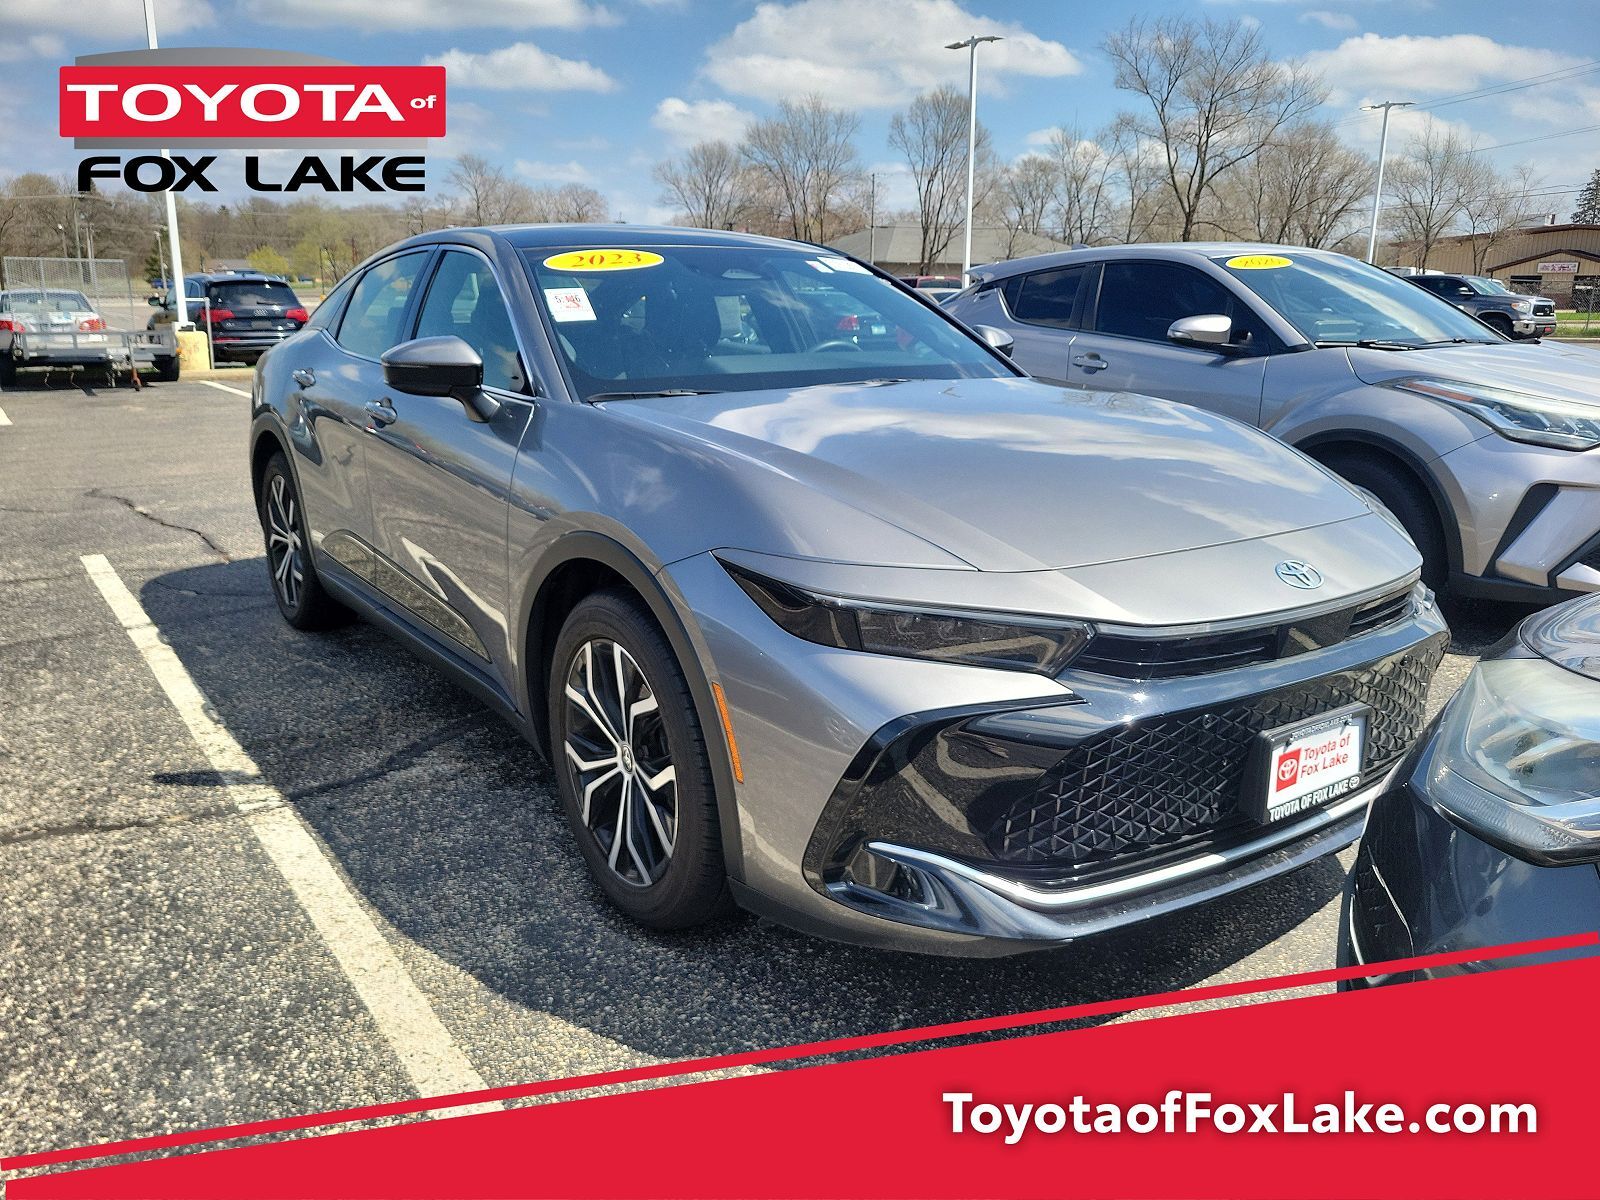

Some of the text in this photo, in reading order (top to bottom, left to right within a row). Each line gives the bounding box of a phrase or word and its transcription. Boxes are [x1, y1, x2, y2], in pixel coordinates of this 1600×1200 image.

[571, 253, 642, 268] 2023
[1304, 733, 1351, 761] Toyota of
[1300, 752, 1349, 778] Fox Lake
[1269, 779, 1350, 823] TOYOTA OF FOX LAKE
